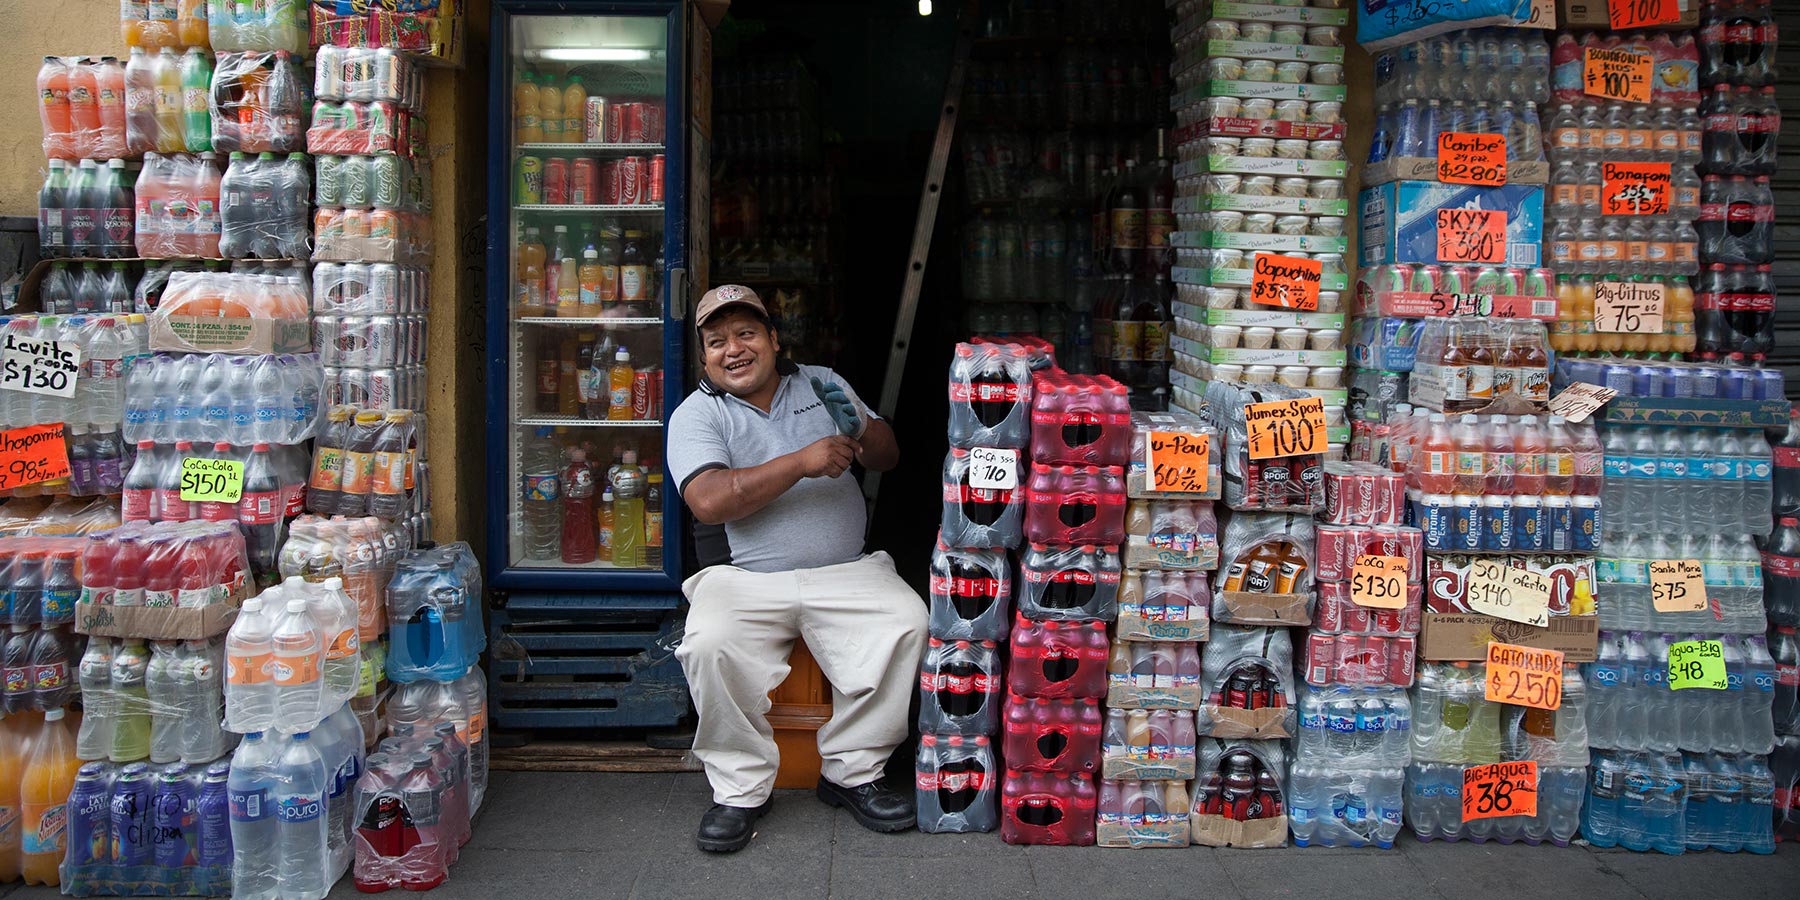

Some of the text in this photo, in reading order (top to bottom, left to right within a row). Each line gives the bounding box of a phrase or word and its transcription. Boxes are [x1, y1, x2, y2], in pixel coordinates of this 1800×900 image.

[1621, 184, 1648, 199] 355
[1437, 210, 1491, 231] SKYY
[1595, 283, 1661, 304] Big-Citrus
[5, 358, 68, 390] $130
[1244, 397, 1324, 421] Jumex-Sport
[9, 459, 38, 483] 98
[181, 470, 227, 495] $150
[1263, 471, 1291, 481] SPORT
[1303, 472, 1322, 481] SPO
[1359, 479, 1373, 518] Coca-Cola
[1427, 508, 1447, 546] Corona Extra
[1466, 508, 1478, 547] Corona
[1499, 508, 1511, 547] Corona
[1533, 508, 1542, 547] Corona
[1591, 509, 1600, 547] Corona
[1355, 554, 1385, 569] CoCa
[1649, 561, 1676, 574] Santa
[1352, 572, 1401, 598] $130
[1470, 581, 1513, 607] $140
[1513, 574, 1548, 593] oferta
[1652, 581, 1687, 601] $75
[82, 613, 117, 631] Splash
[1490, 645, 1561, 676] GATORADE
[1669, 640, 1722, 662] Agua-Big
[1669, 661, 1704, 683] $48
[1491, 671, 1560, 709] $250
